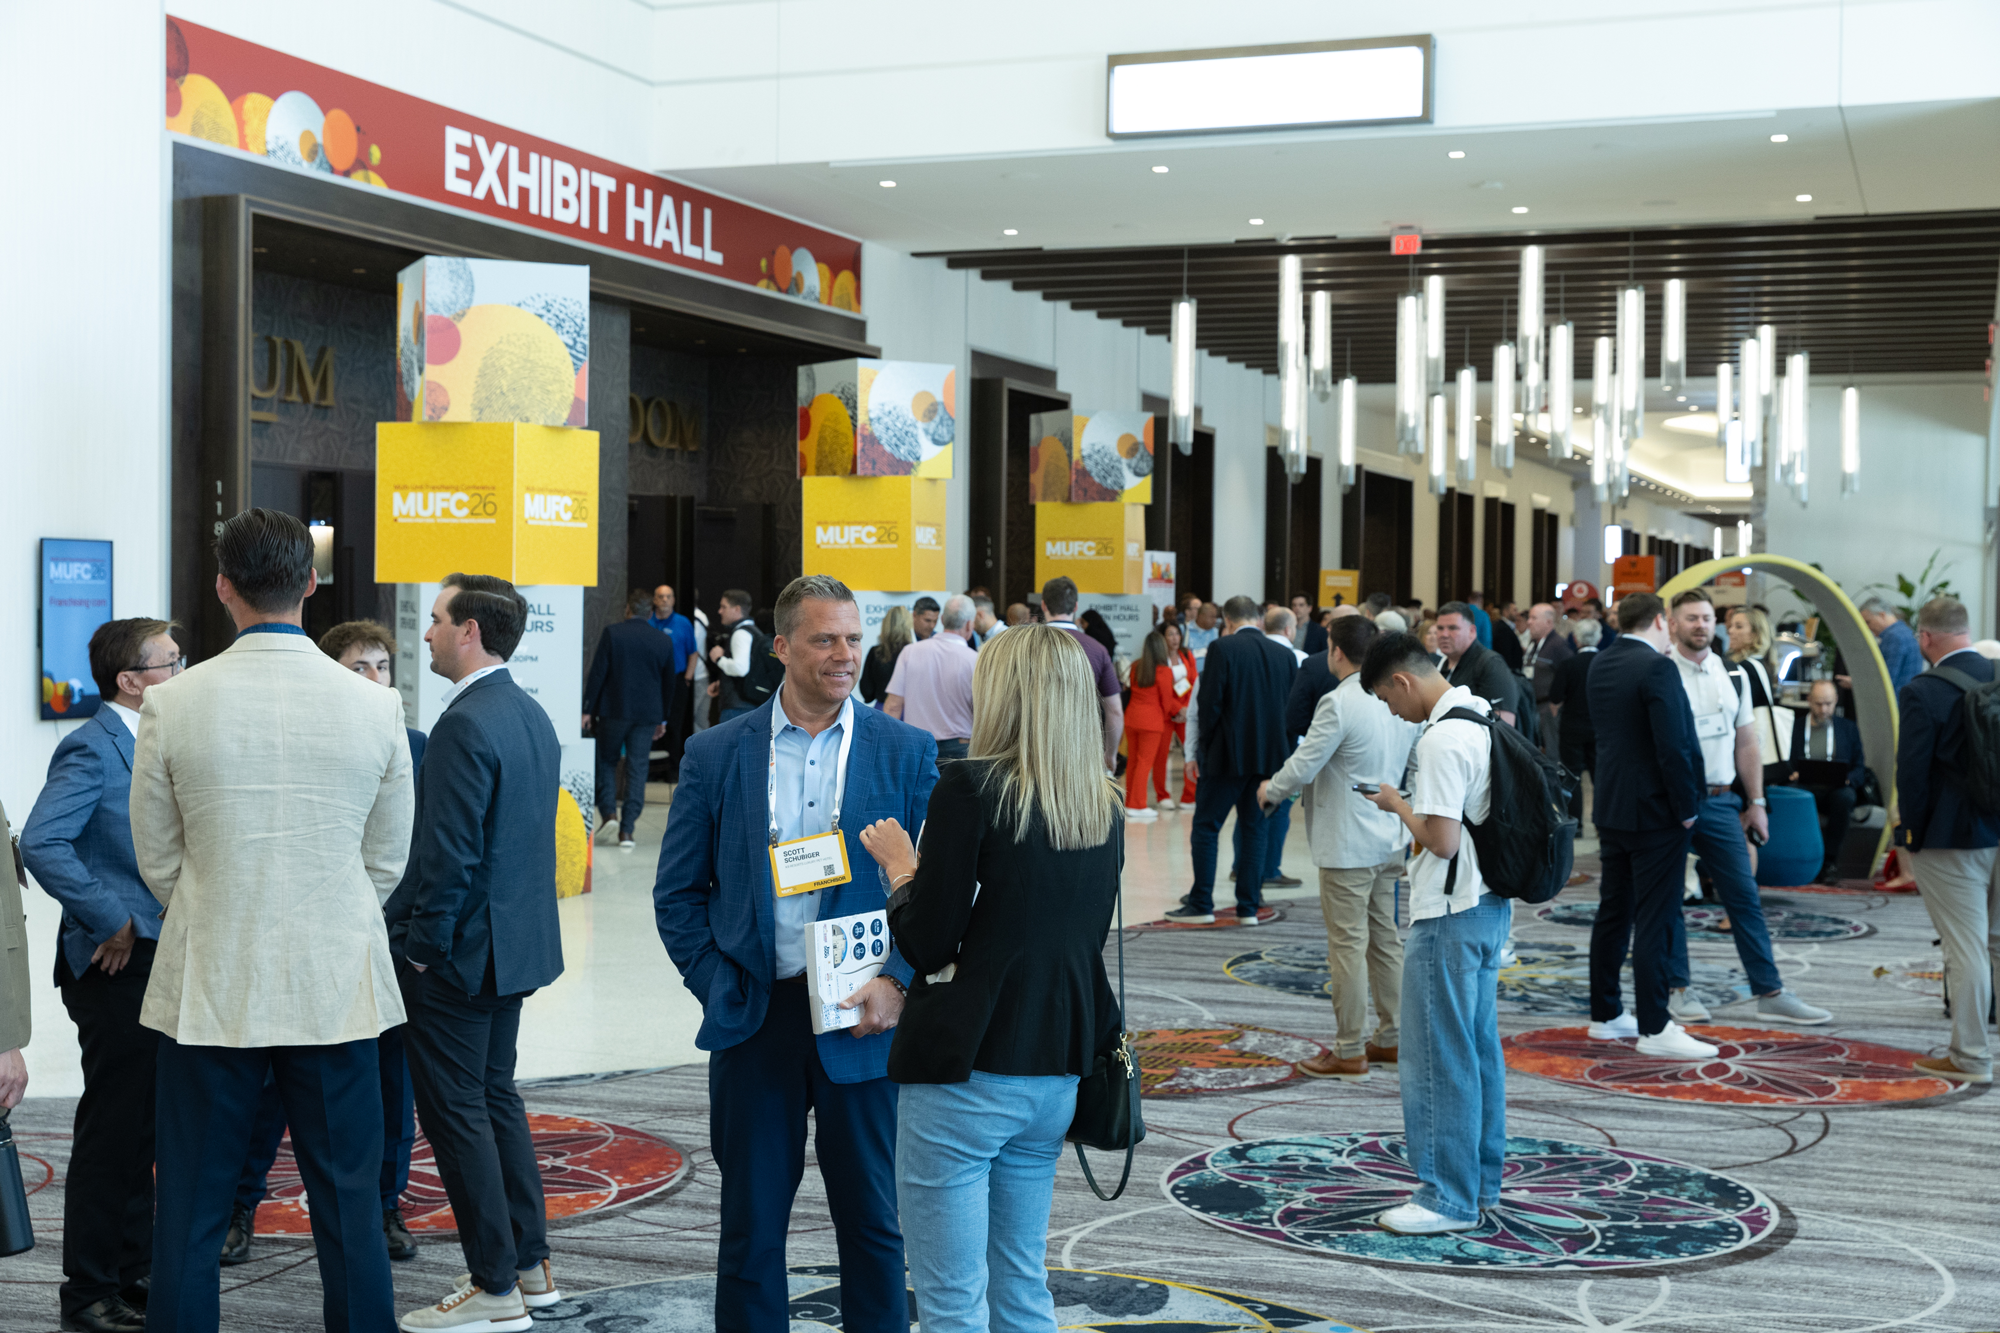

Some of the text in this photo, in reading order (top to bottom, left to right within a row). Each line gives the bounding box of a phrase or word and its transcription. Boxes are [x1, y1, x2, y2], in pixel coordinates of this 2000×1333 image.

[445, 125, 724, 266] EXHIBIT HALL
[393, 491, 497, 517] MUFC26
[524, 493, 588, 521] MUFC26
[816, 525, 899, 545] MUFC26
[1046, 541, 1115, 556] MUFC26
[783, 848, 805, 857] SCOTT
[784, 851, 820, 864] SCHUBIGER
[814, 876, 846, 887] FRANCHISOR
